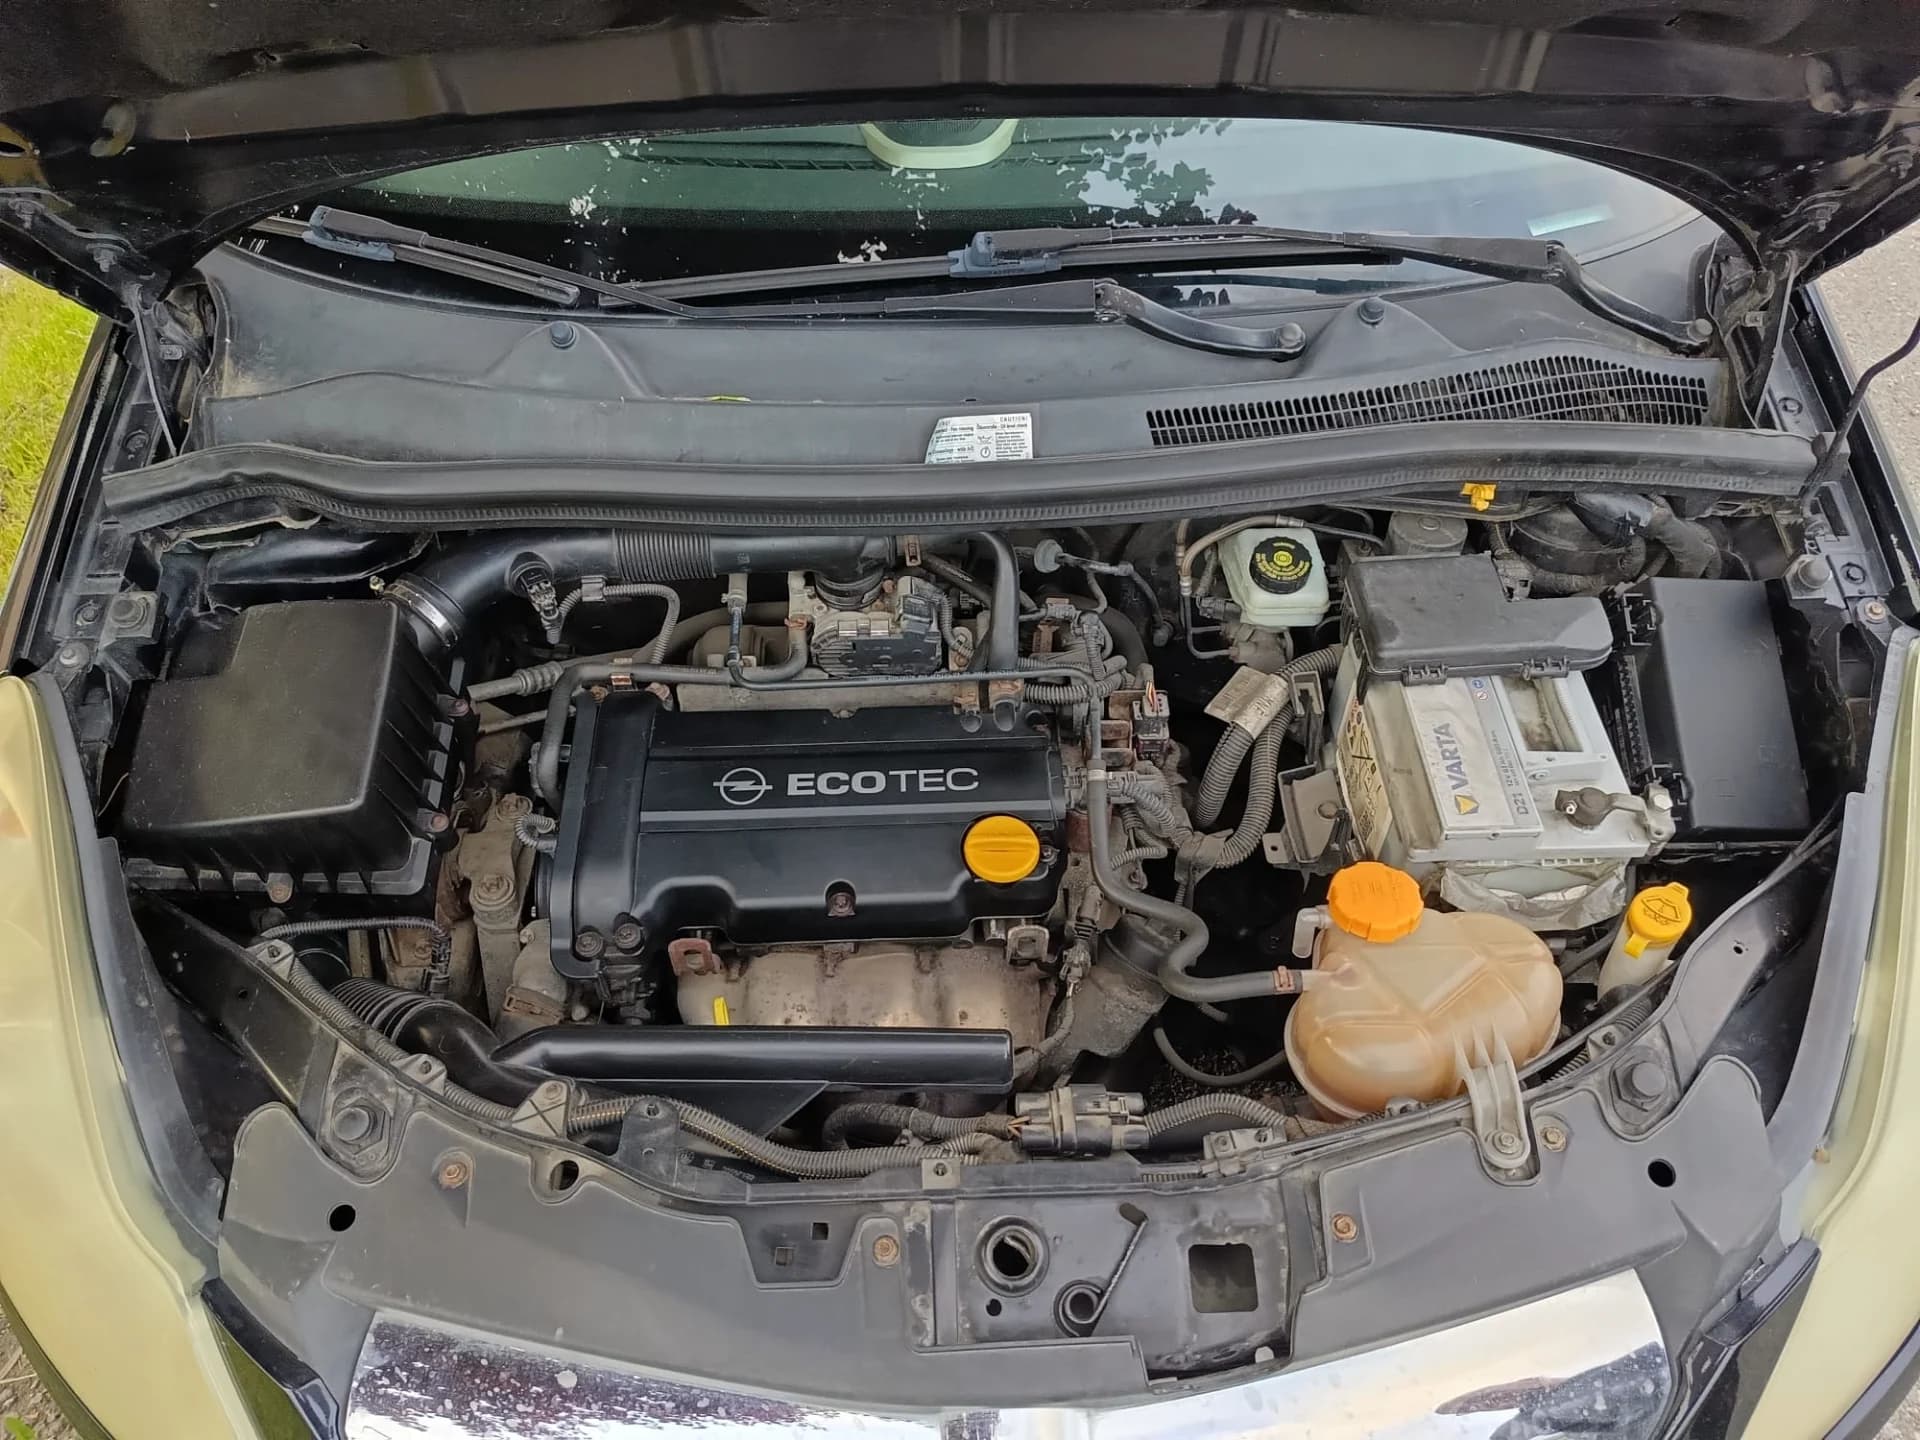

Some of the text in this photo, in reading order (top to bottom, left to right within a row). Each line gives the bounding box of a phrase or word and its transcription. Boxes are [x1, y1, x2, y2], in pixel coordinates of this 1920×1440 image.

[1433, 722, 1469, 790] VARTA
[787, 767, 979, 796] ECOTEC
[1512, 793, 1529, 815] D21
